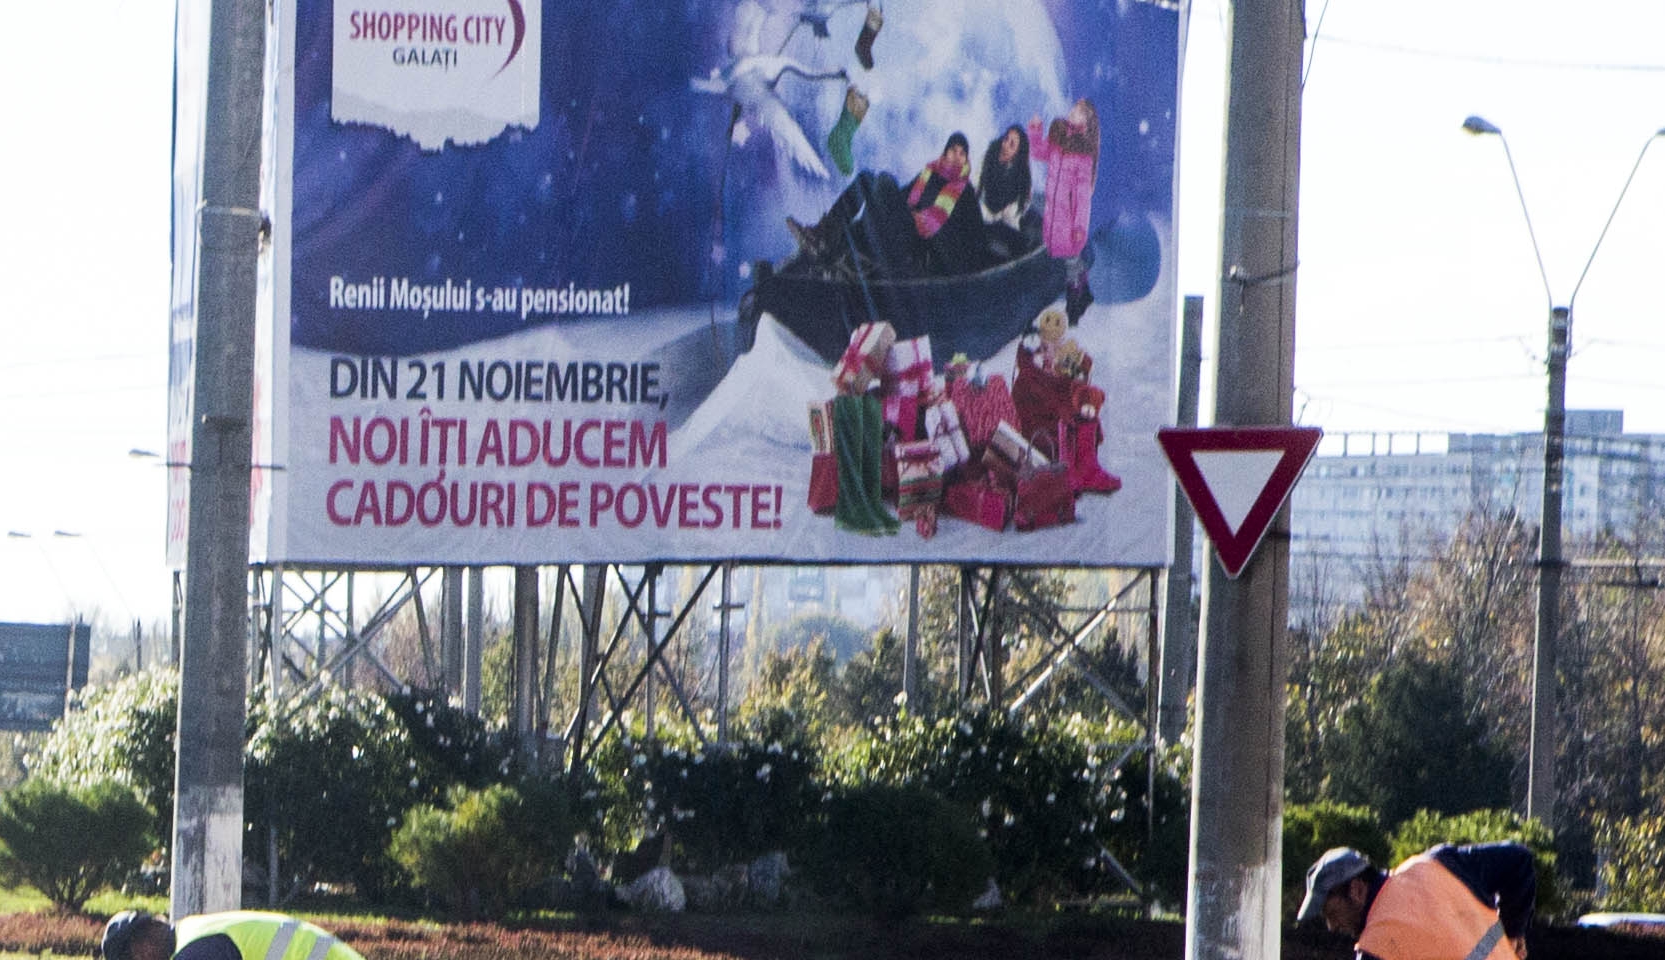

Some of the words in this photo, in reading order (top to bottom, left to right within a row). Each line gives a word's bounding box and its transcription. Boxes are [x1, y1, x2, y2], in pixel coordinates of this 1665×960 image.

[349, 10, 458, 43] SHOPPING
[463, 14, 506, 45] CITY
[329, 275, 385, 309] Renii
[389, 277, 472, 320] Moșului
[475, 285, 517, 312] s-au
[521, 281, 631, 321] pensionat!
[329, 357, 398, 400] DIN
[405, 360, 445, 400] 21
[458, 360, 670, 410] NOIEMBRIE,
[329, 415, 409, 466] NOI
[475, 416, 668, 469] ADUCEM
[325, 478, 516, 528] CADOURI
[525, 481, 580, 528] DE
[588, 484, 784, 530] POVESTE!
